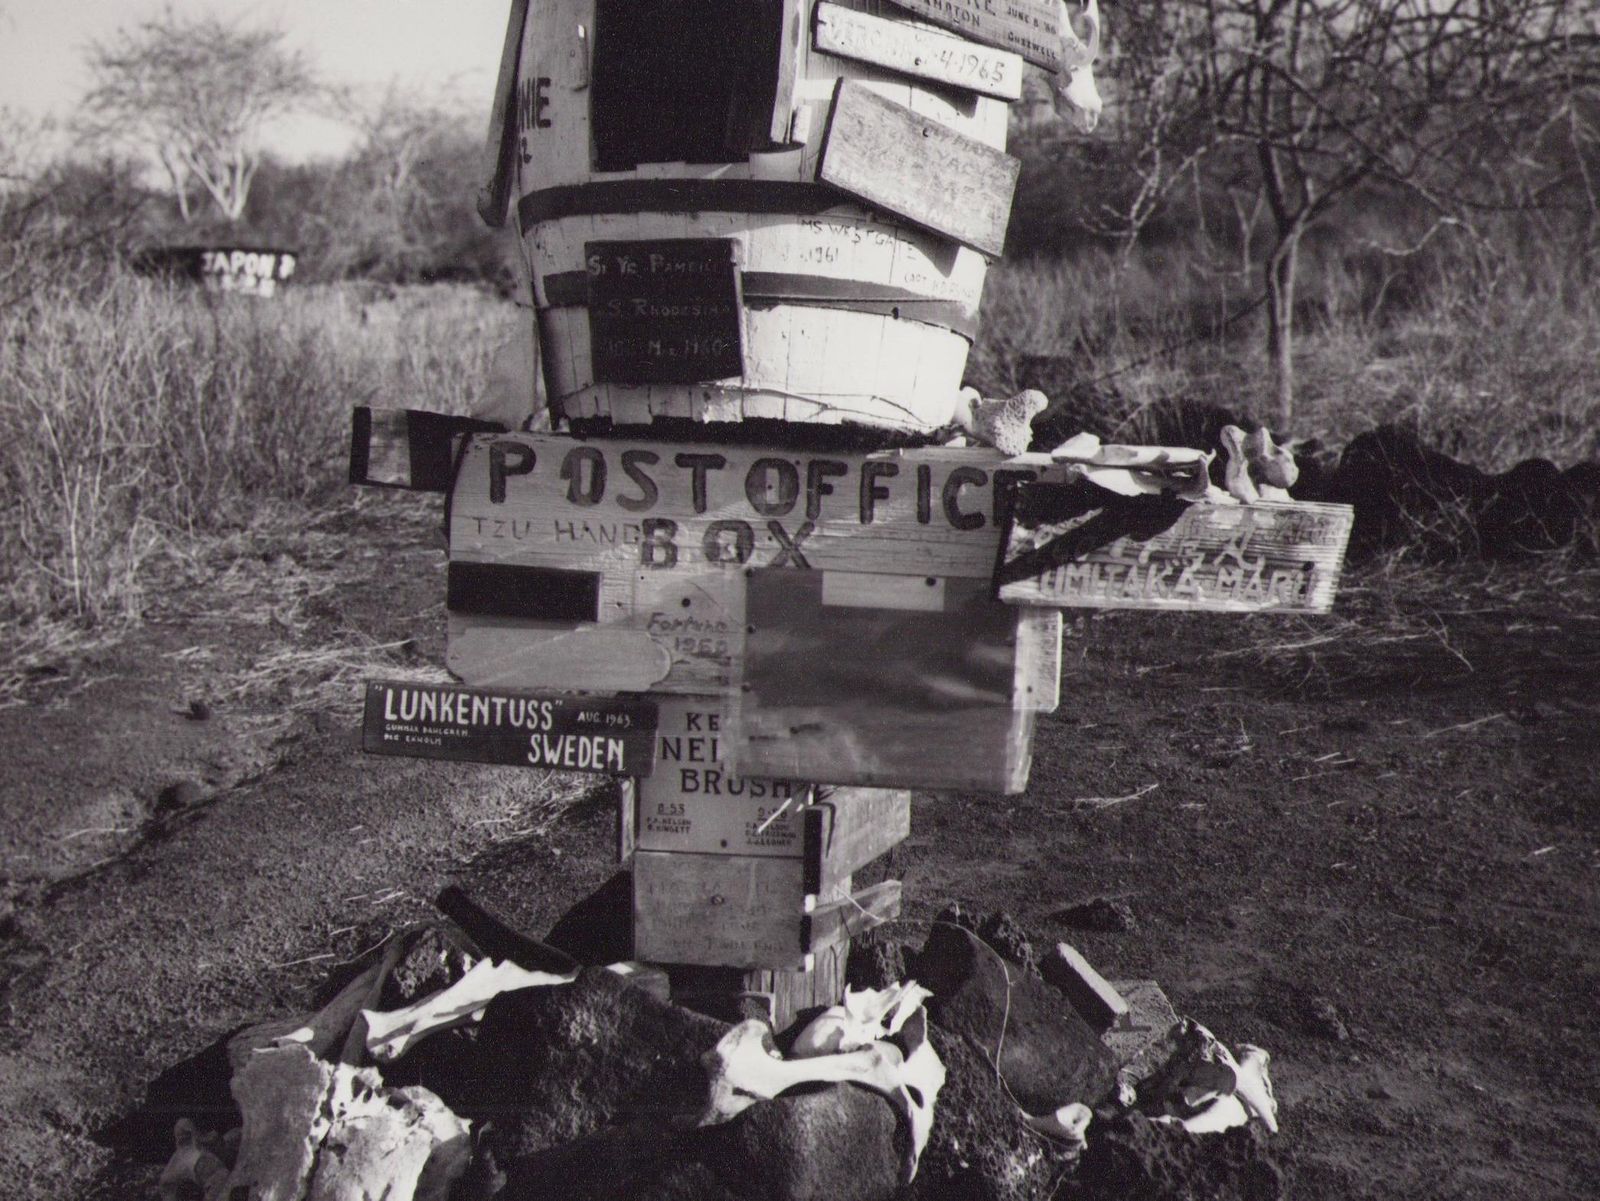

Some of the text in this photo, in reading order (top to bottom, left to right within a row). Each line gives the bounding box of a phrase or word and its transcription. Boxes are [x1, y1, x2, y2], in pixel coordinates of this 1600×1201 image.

[489, 441, 727, 514] POST
[471, 517, 531, 541] TZU
[640, 517, 815, 570] BOX
[527, 733, 627, 772] SWEDEN
